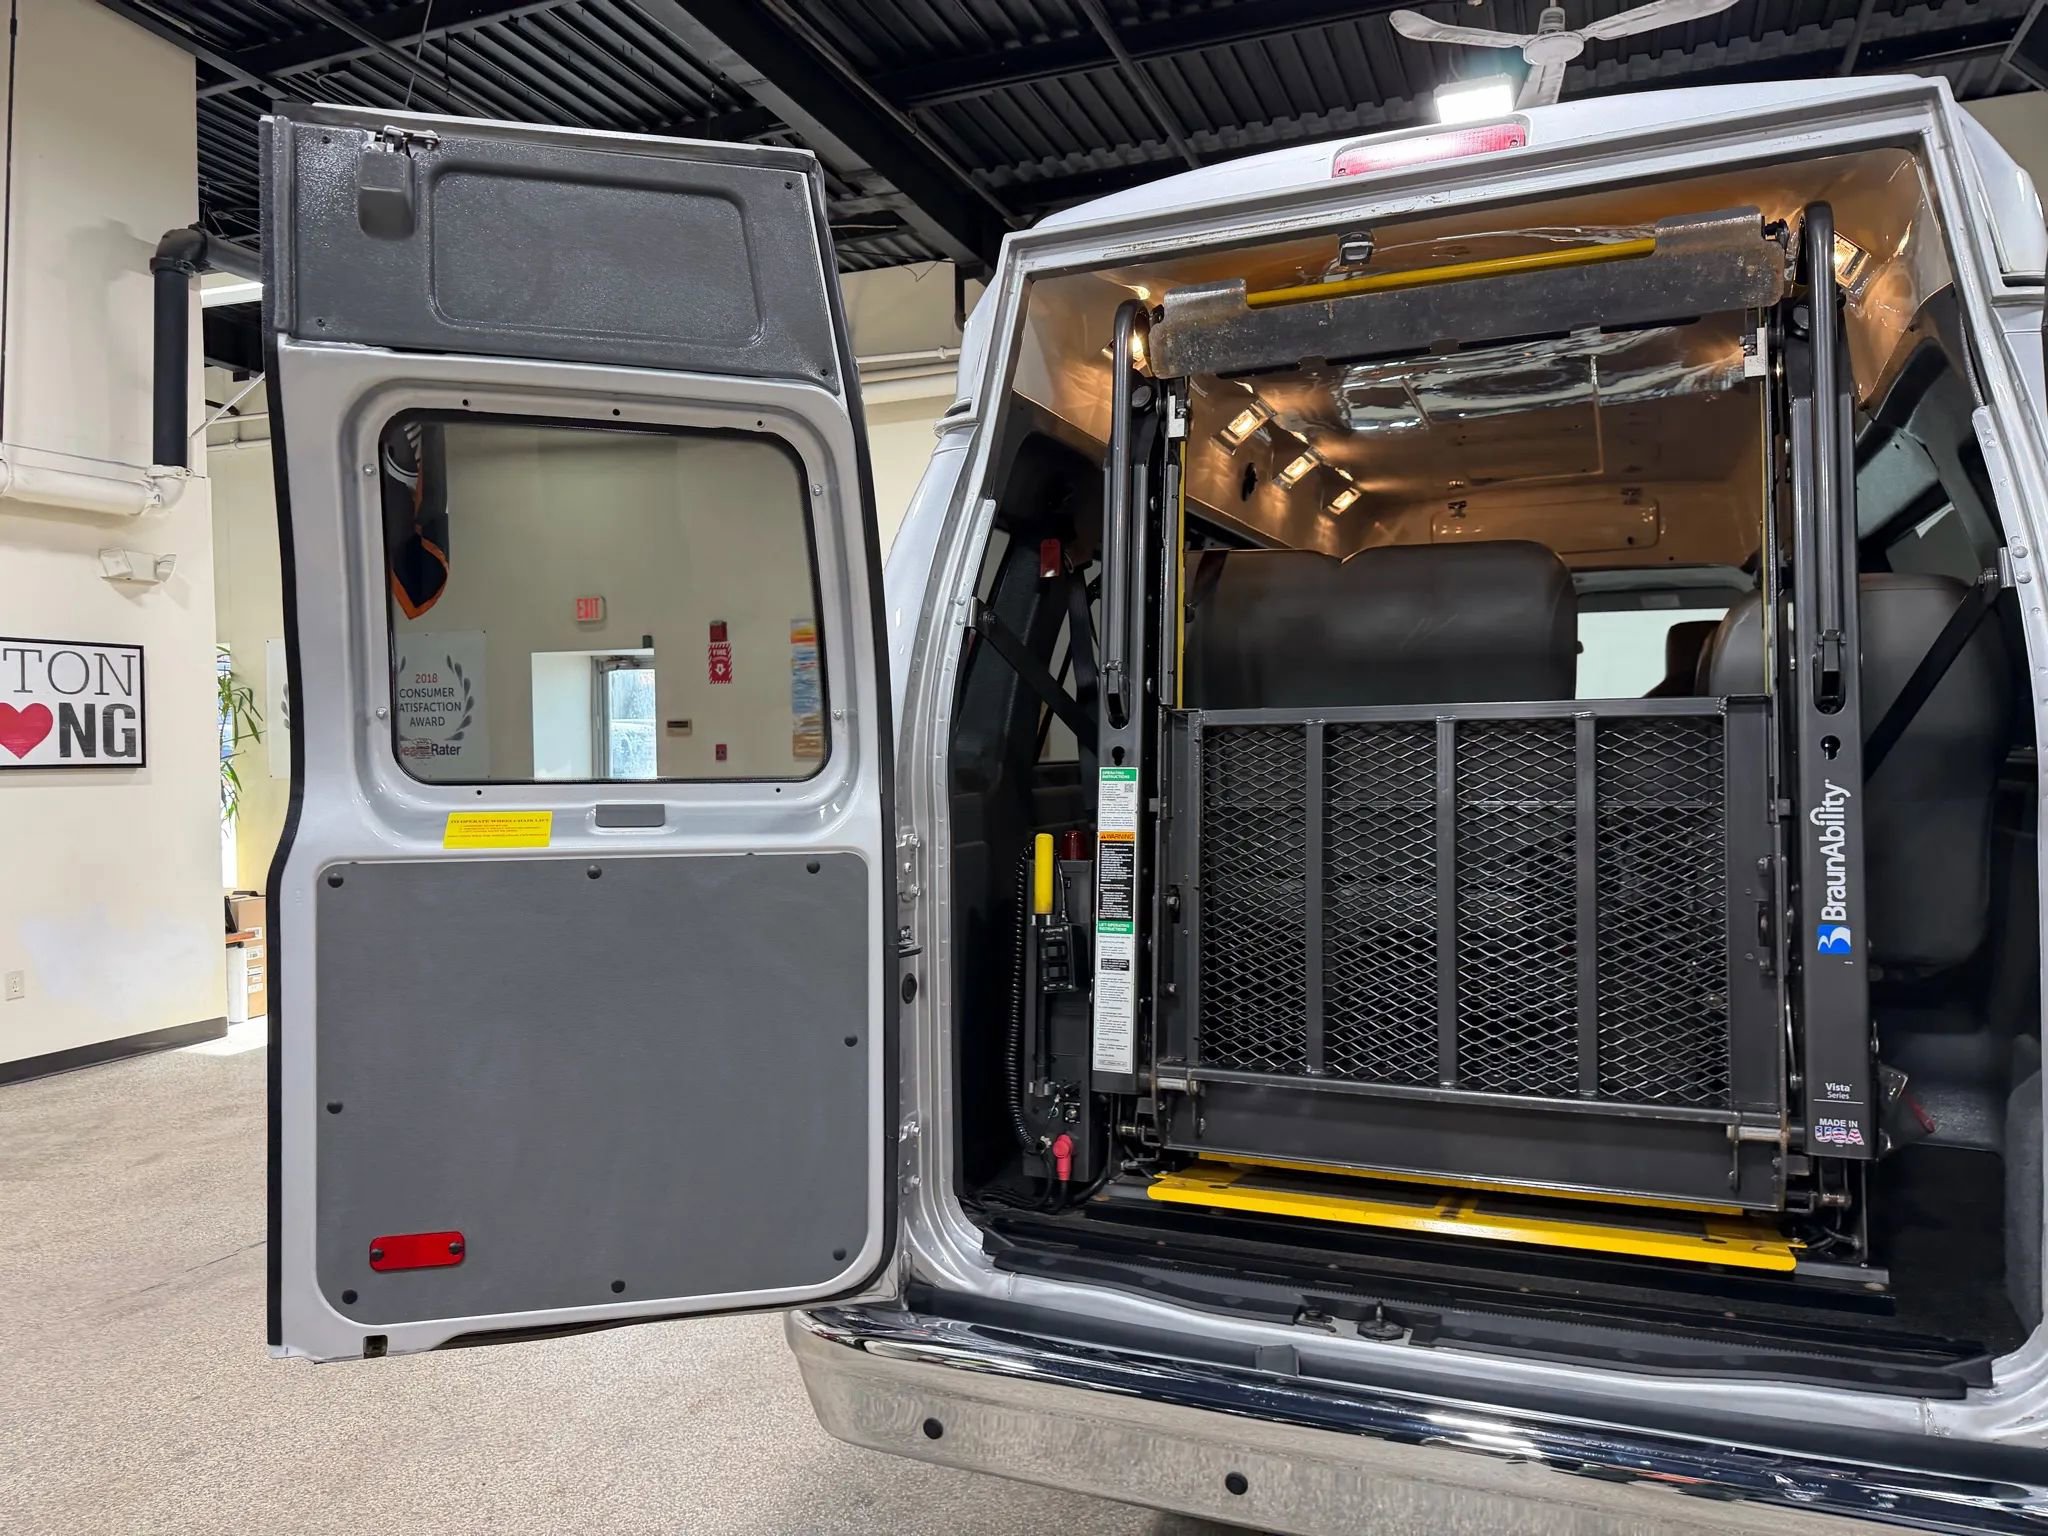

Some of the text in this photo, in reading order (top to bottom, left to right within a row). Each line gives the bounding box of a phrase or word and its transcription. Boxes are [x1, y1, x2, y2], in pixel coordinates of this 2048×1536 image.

[576, 597, 600, 620] EXIT
[712, 648, 728, 656] FIRE
[2, 647, 137, 697] TON
[415, 673, 438, 684] 2018
[399, 687, 455, 699] CONSUMER
[399, 701, 462, 713] ATISFACTION
[409, 716, 446, 728] AWARD
[1809, 779, 1852, 921] BraunAbility
[1827, 1091, 1850, 1099] Series
[1819, 1118, 1858, 1128] MADE IN
[1815, 1125, 1865, 1146] USA
